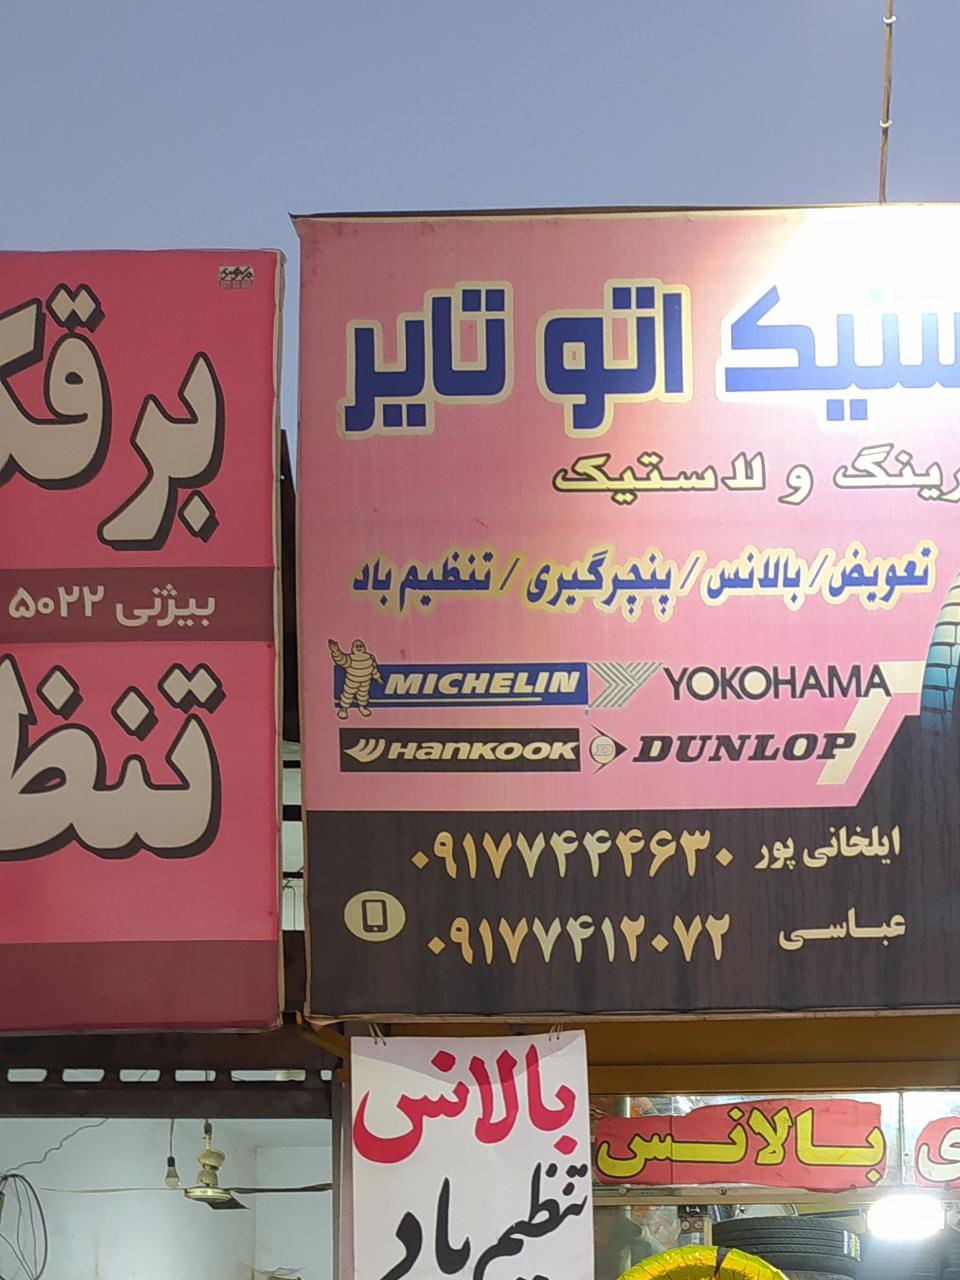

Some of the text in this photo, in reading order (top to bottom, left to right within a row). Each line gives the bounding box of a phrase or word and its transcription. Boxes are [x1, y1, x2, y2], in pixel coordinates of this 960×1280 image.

[342, 286, 509, 433] تایر
[542, 283, 686, 432] اتو
[552, 450, 766, 506] لاستیک
[778, 463, 814, 506] و
[352, 557, 393, 607] باد
[399, 550, 495, 614] تنظیم
[525, 549, 672, 616] پنچرگیری
[706, 550, 801, 605] بالانس
[828, 546, 932, 603] تعویض
[8, 581, 216, 627] بیژنی ۵۰۲۲
[383, 670, 582, 695] MICHELIN
[662, 664, 892, 701] YOKOHAMA
[632, 730, 859, 764] DUNLOP
[410, 825, 902, 879] ایلخانی پور ۰۹۱۷۷۴۴۴۶۳۰
[426, 907, 906, 965] عباسی ۰۹۱۷۷۴۱۲۰۷۲
[353, 1043, 578, 1164] بالانس
[597, 1105, 887, 1183] بالانس
